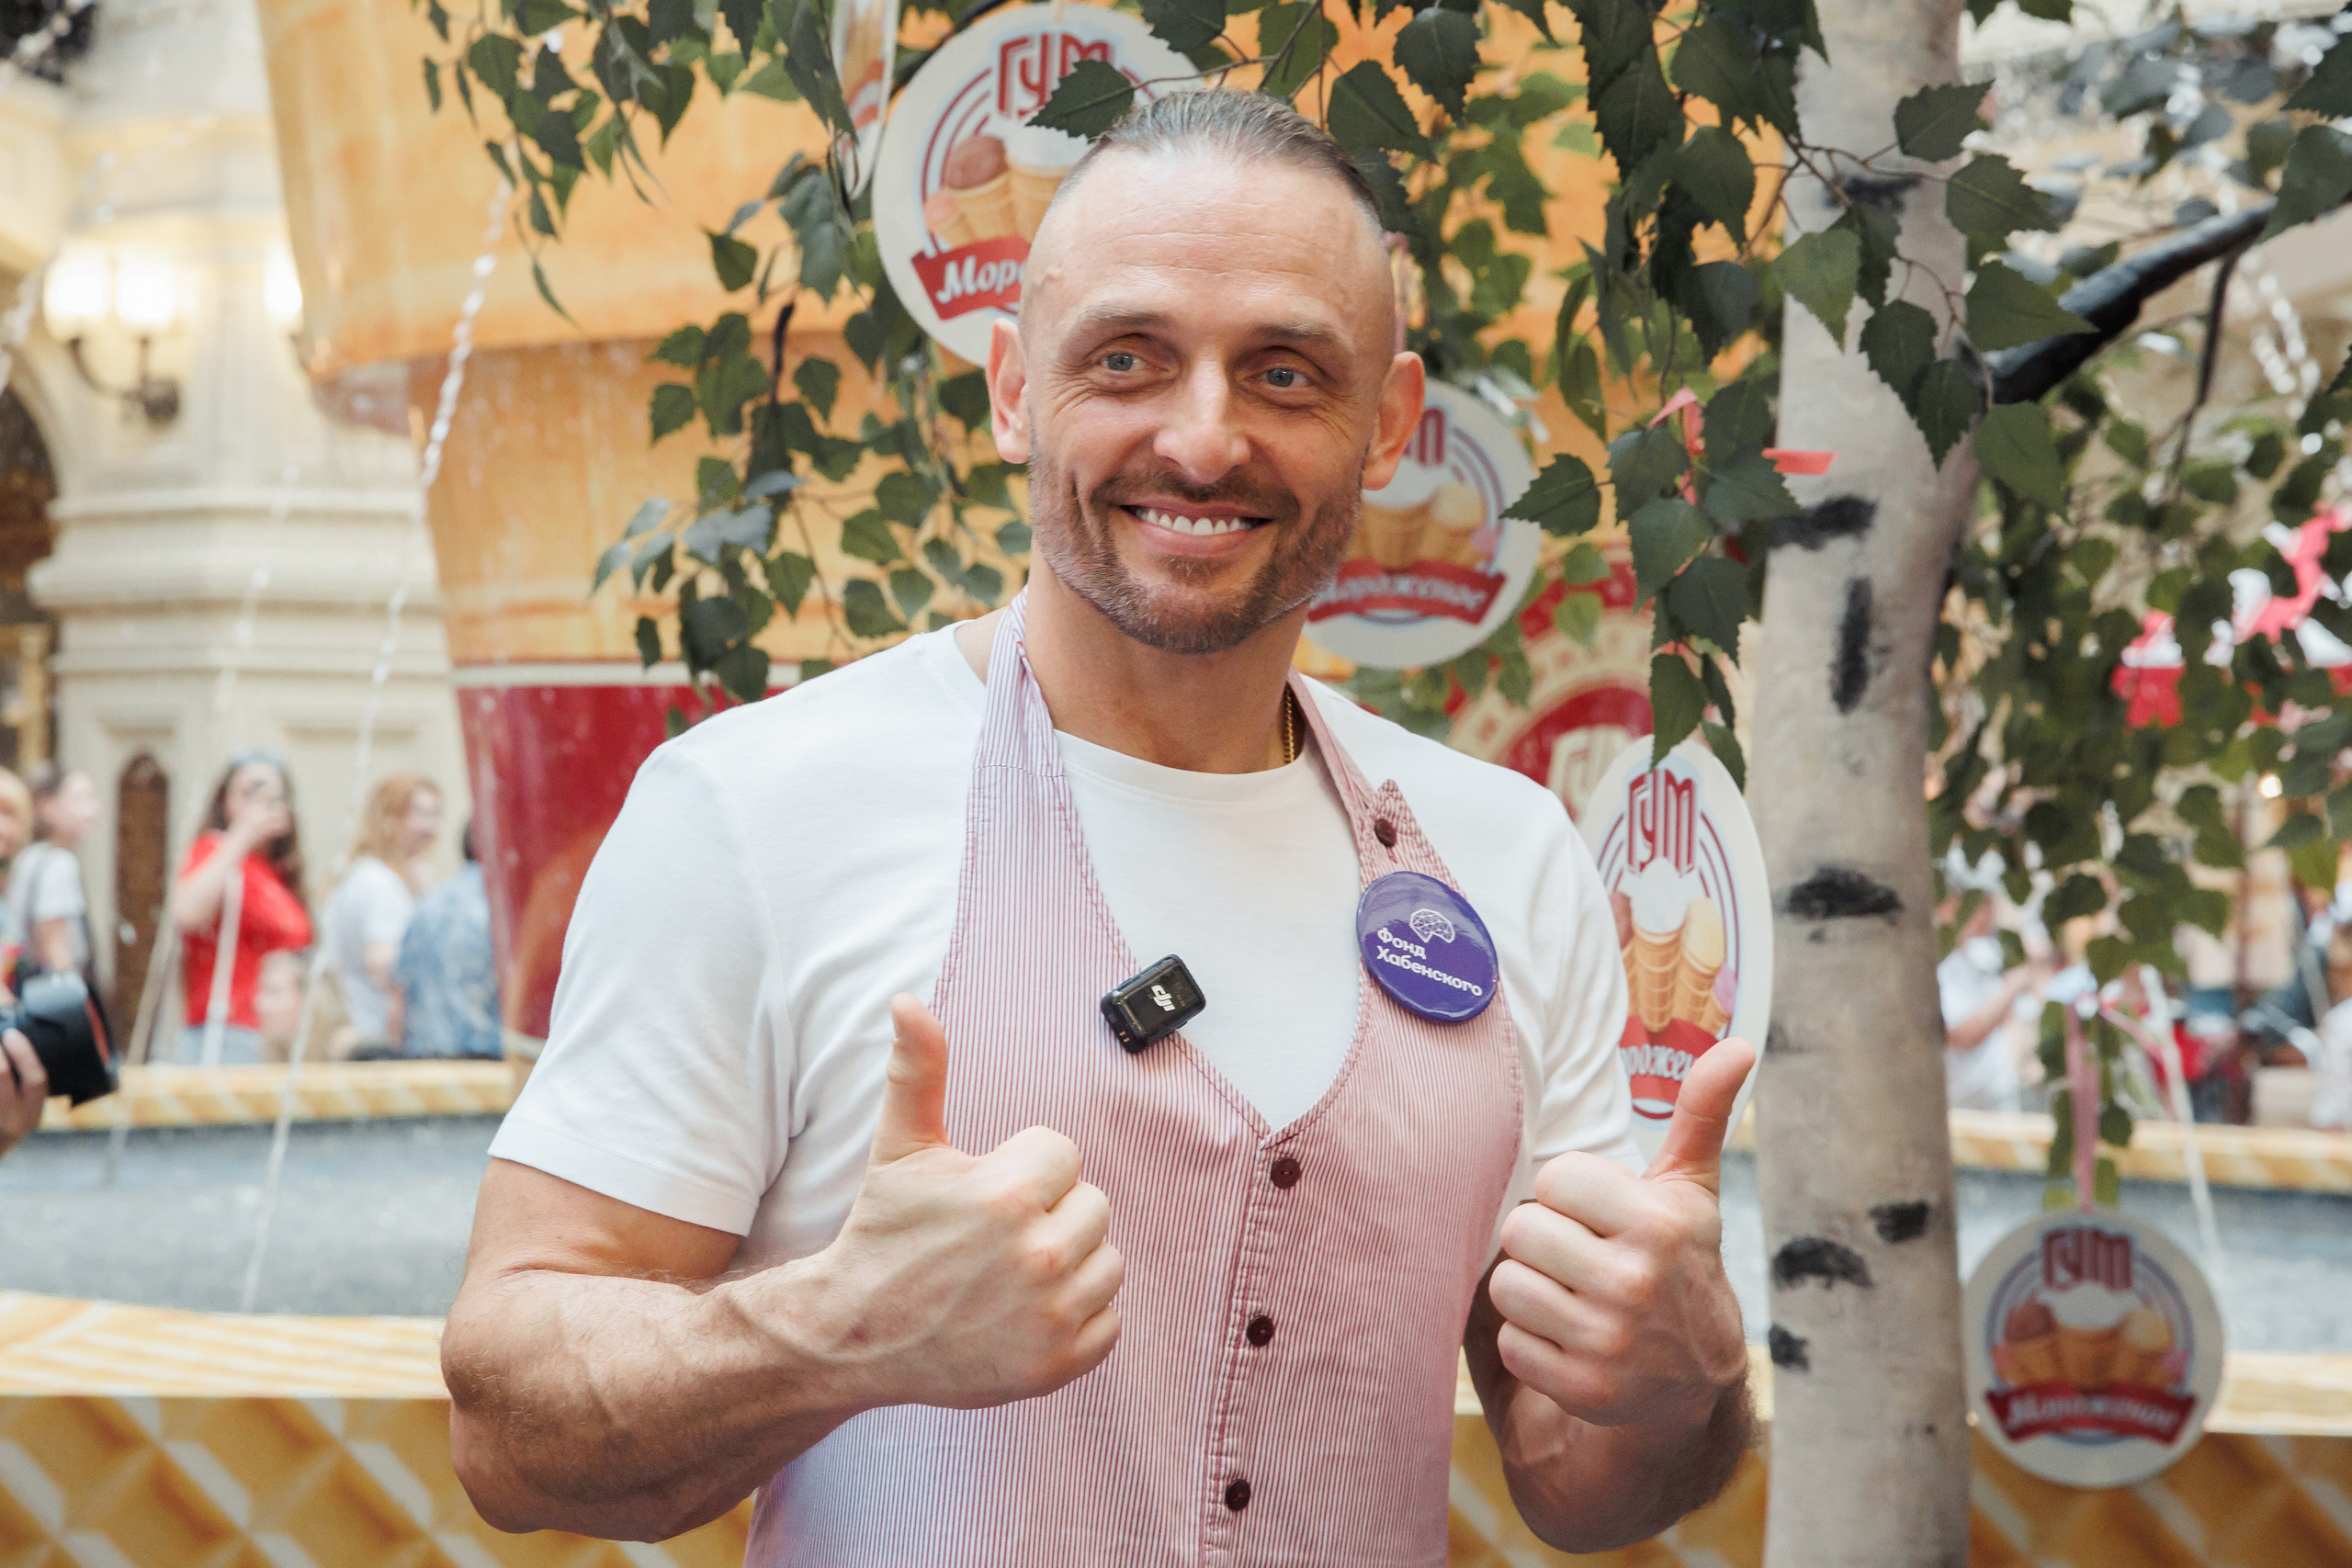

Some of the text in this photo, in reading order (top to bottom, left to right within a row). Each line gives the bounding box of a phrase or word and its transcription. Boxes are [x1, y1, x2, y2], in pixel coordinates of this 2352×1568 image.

[1628, 768, 1697, 875] ГУМ
[1376, 927, 1427, 960] Фонд
[1376, 945, 1484, 997] Хабенского
